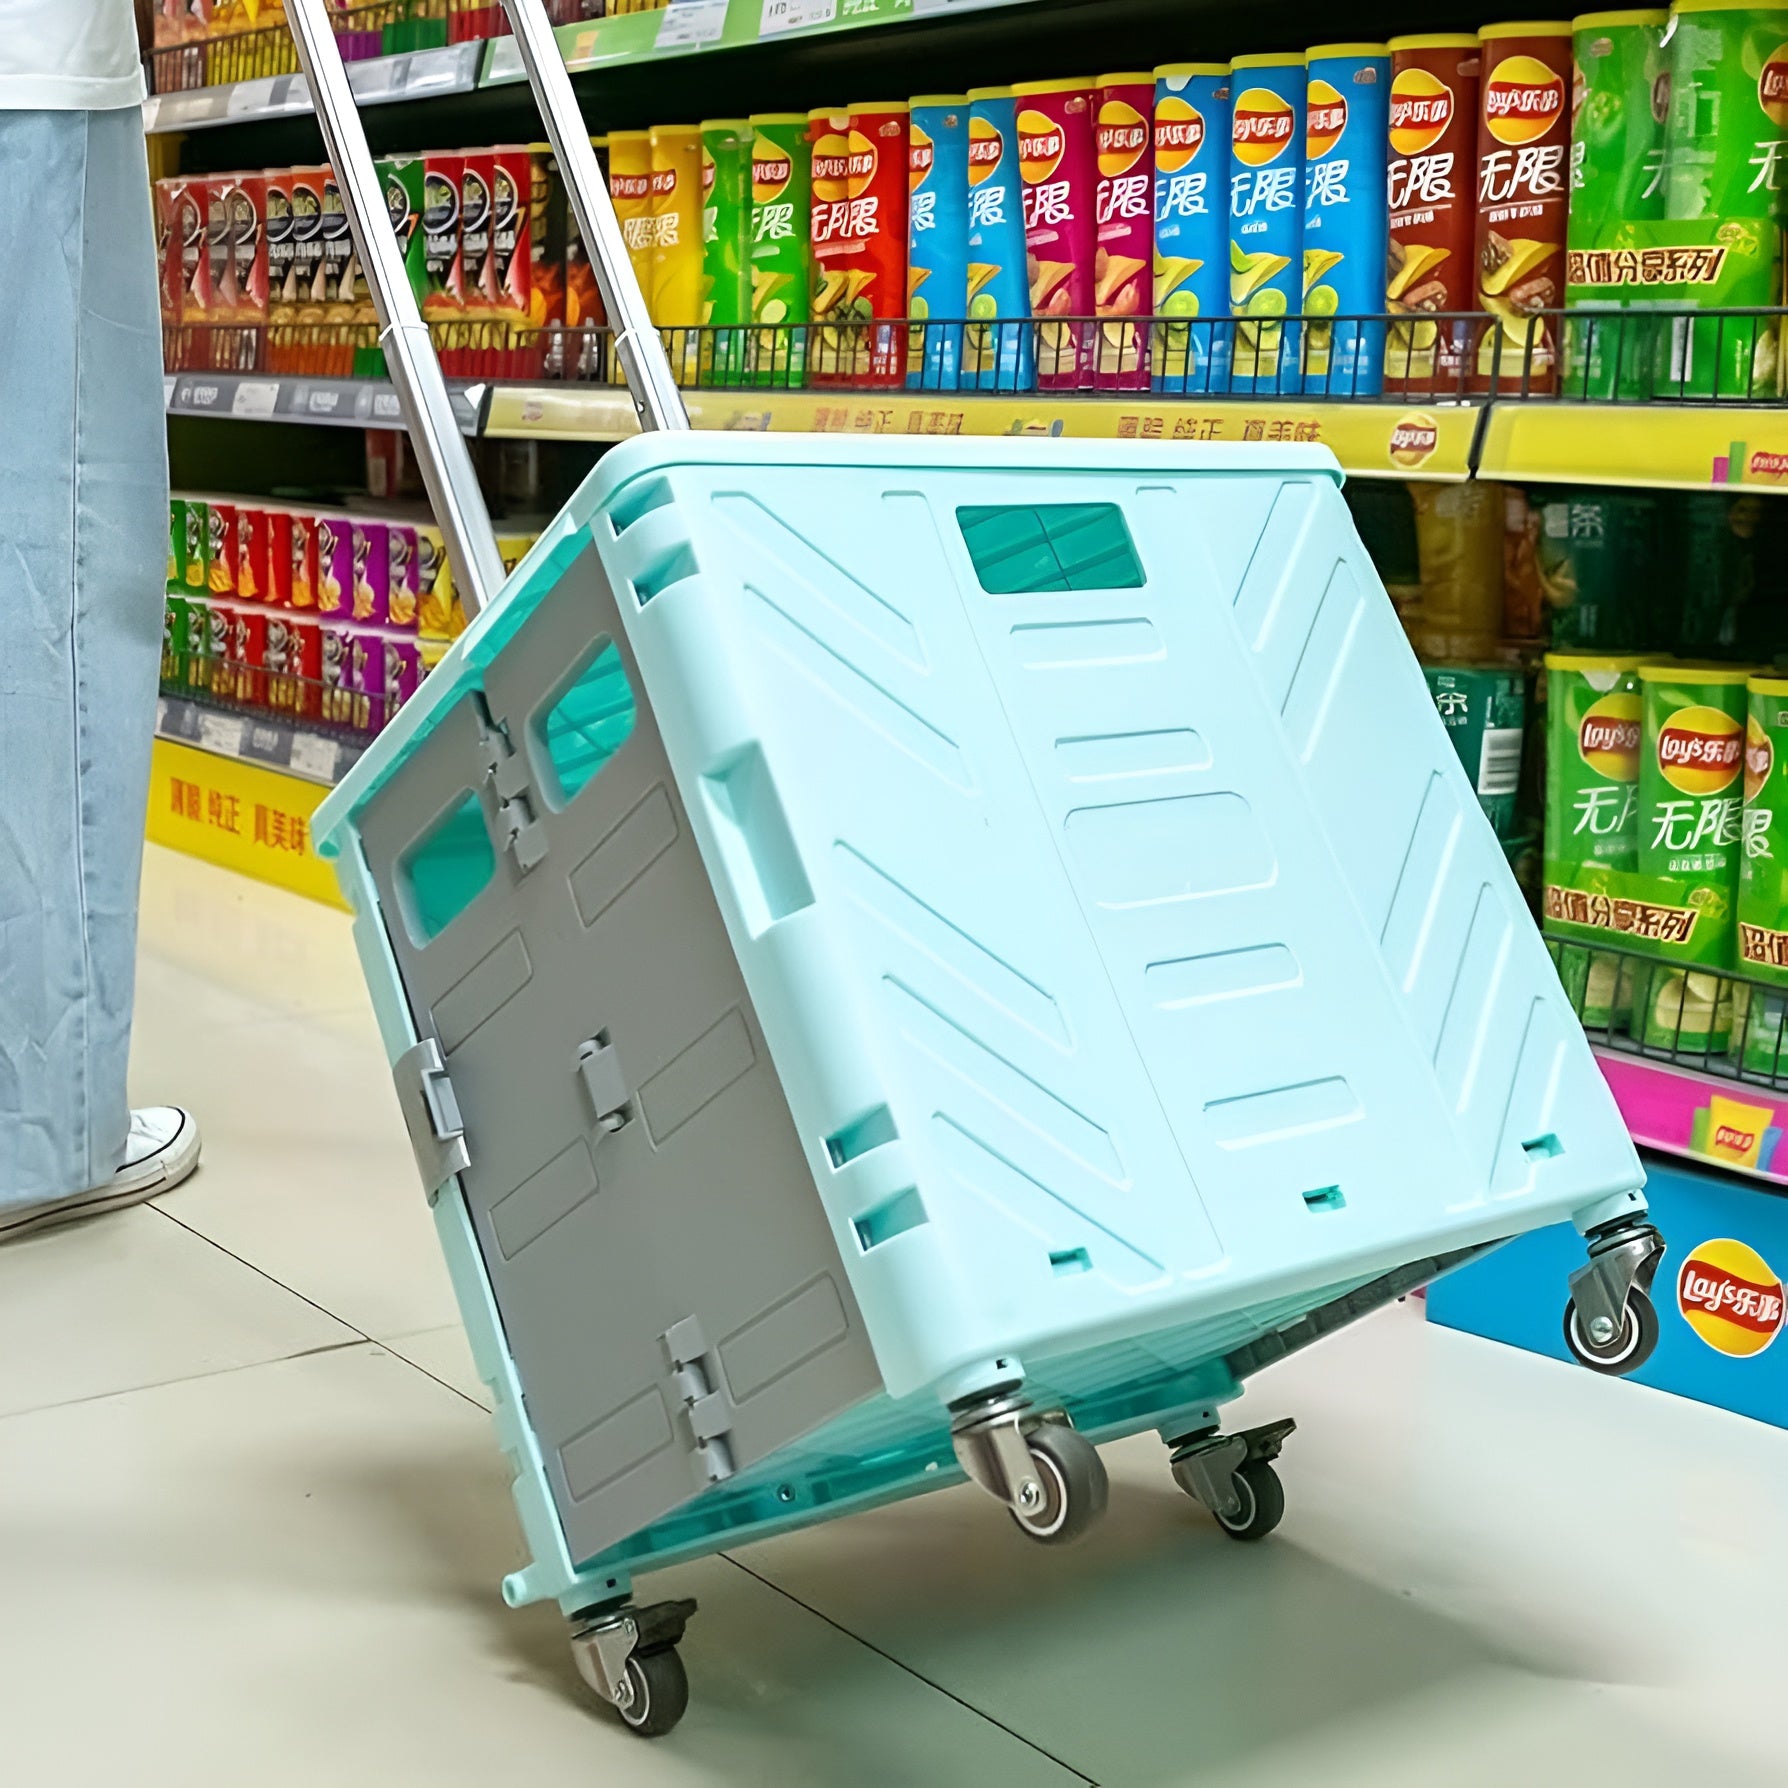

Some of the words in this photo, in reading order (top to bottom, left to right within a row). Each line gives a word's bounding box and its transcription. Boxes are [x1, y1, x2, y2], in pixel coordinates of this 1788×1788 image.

[1230, 167, 1296, 217] 无限
[1479, 146, 1565, 203] 无限
[1683, 1269, 1737, 1312] Lay's
